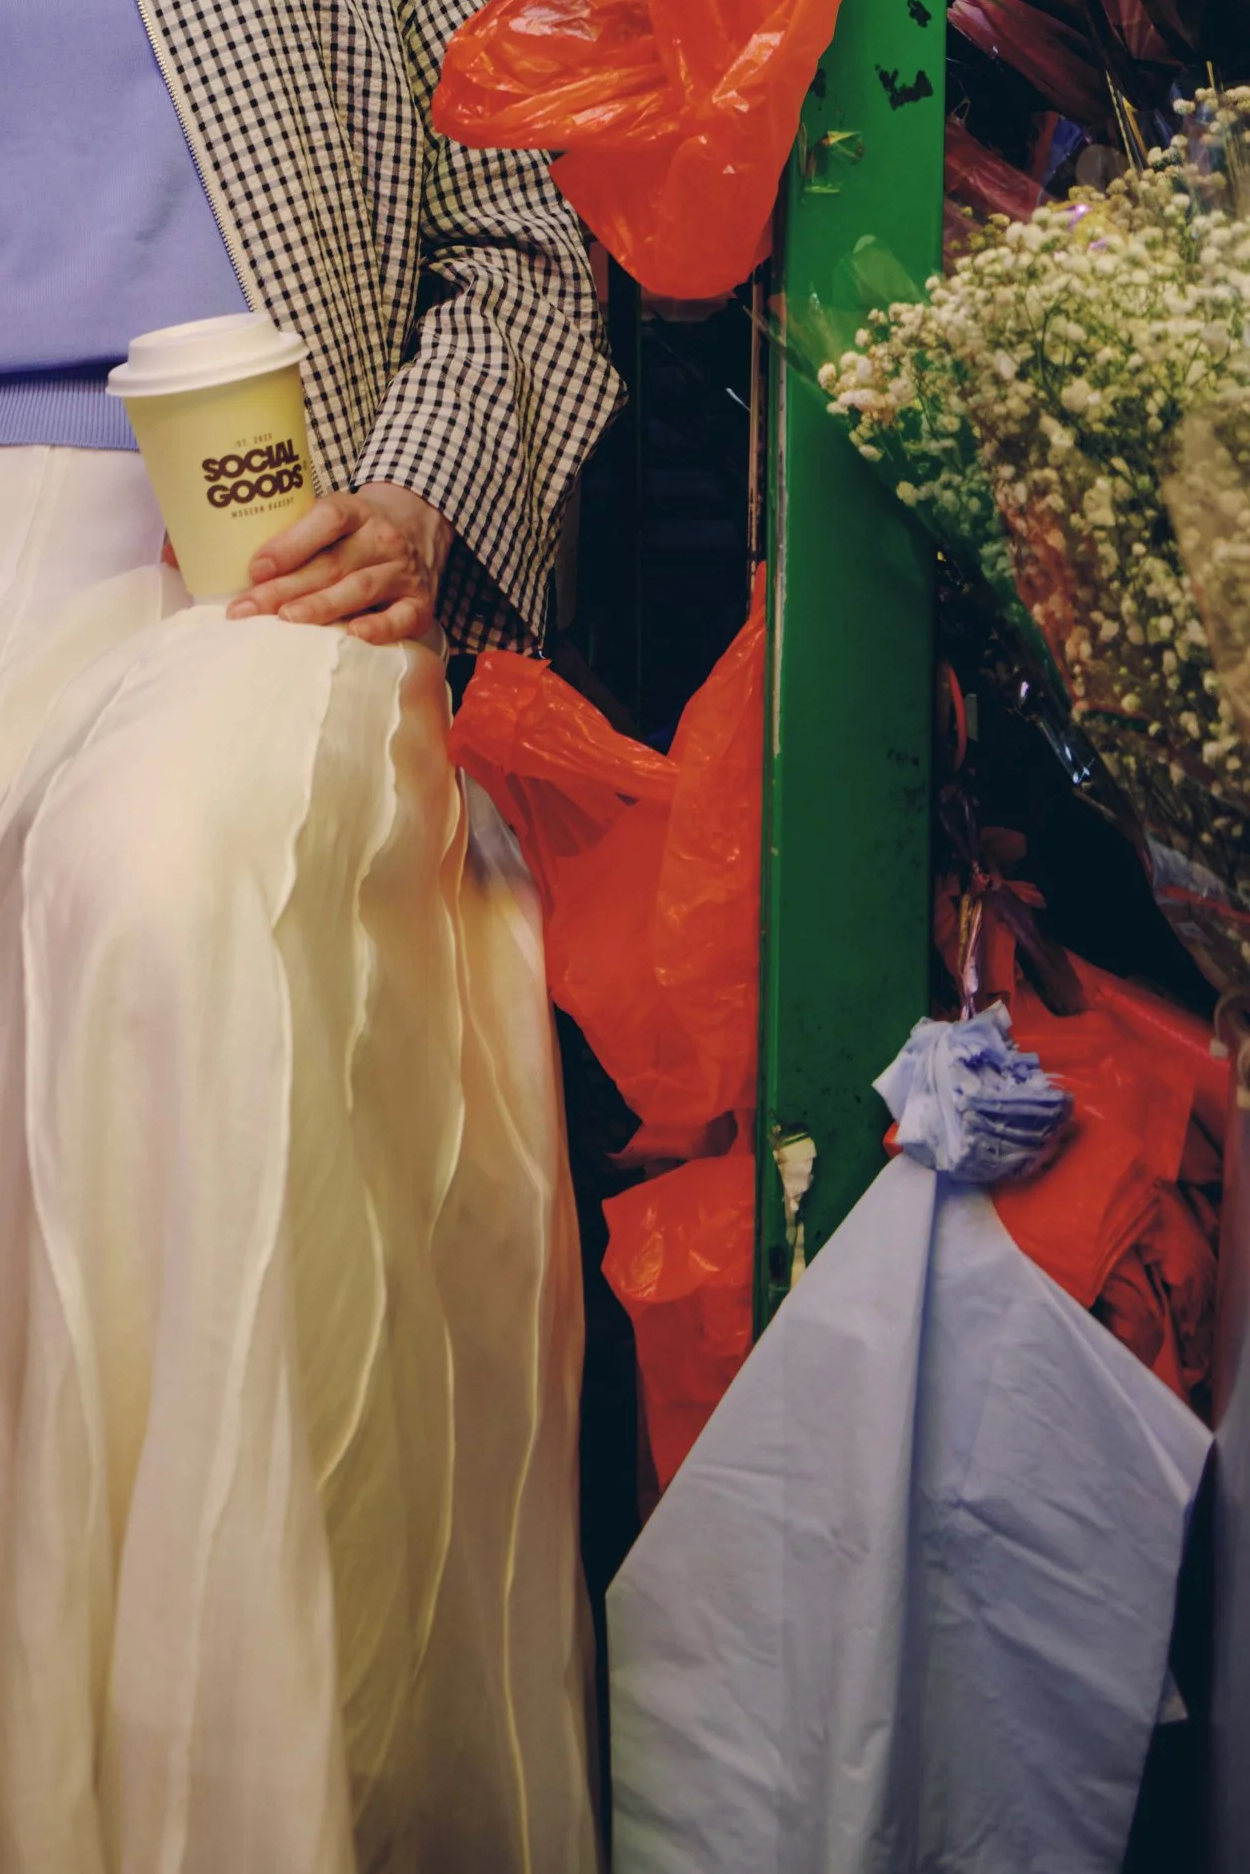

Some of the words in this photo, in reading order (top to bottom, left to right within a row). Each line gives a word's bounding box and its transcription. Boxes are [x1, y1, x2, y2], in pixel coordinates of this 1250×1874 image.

[202, 439, 299, 482] SOCIAL
[207, 464, 304, 508] GOODS
[231, 505, 266, 519] MODERN
